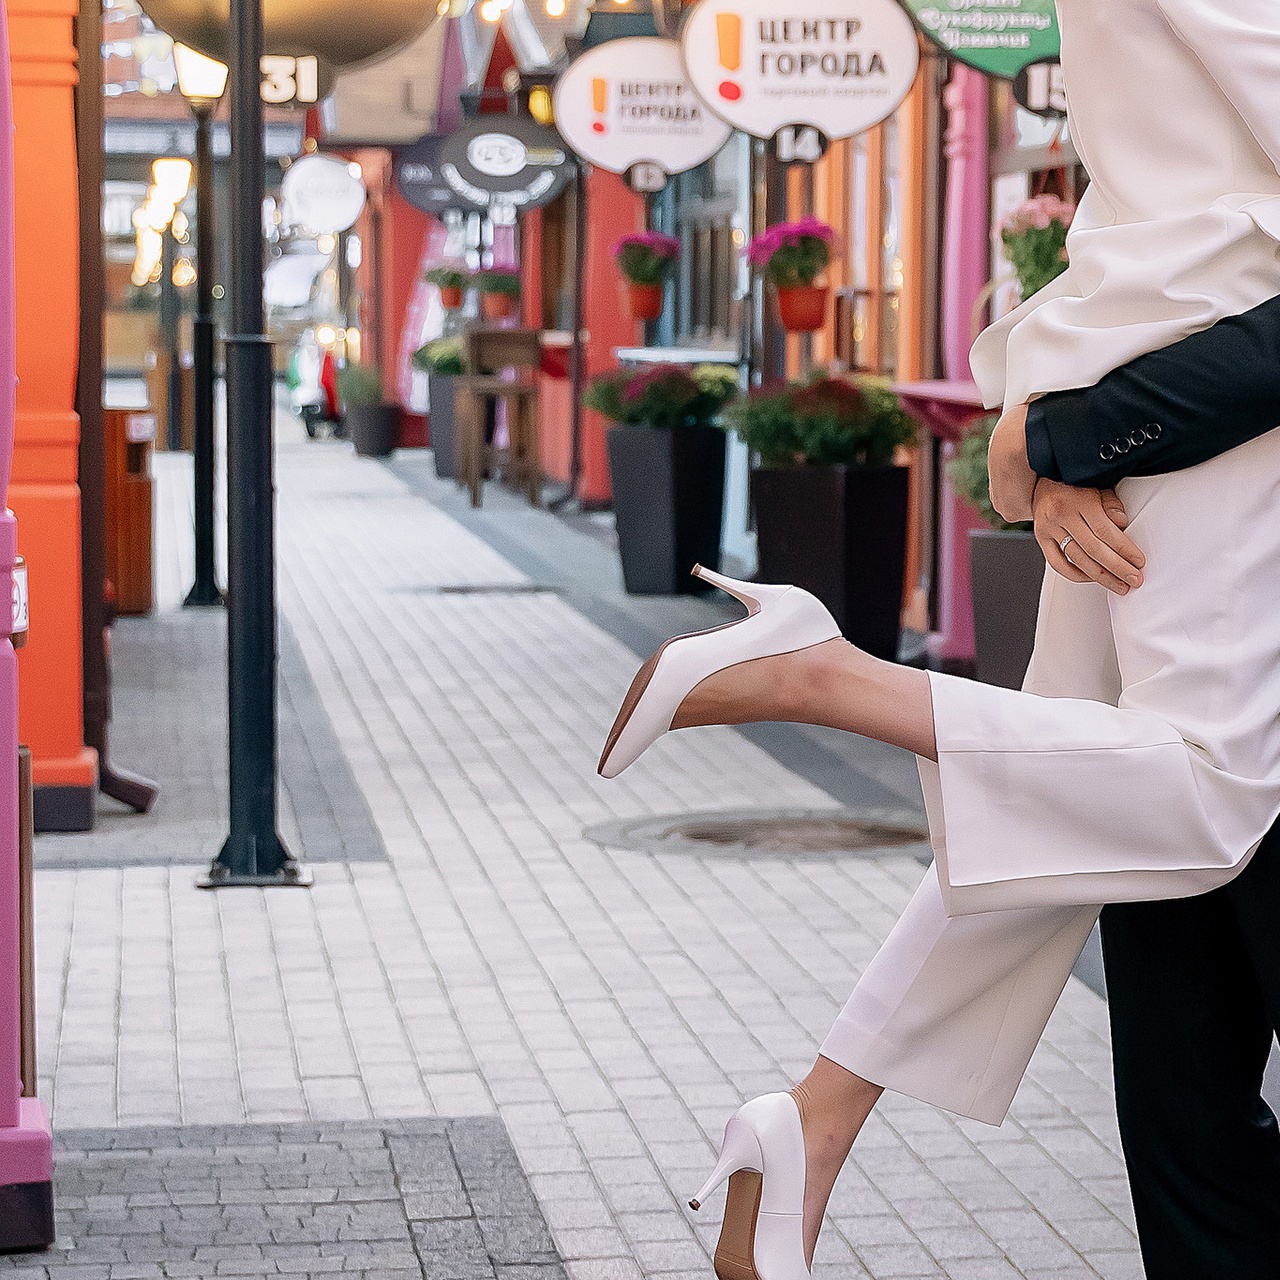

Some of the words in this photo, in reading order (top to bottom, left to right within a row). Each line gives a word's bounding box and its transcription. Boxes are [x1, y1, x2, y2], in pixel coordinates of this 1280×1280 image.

[758, 18, 862, 44] ЦЕНТР
[259, 55, 318, 104] 31
[759, 52, 886, 77] ГОРОДА
[776, 125, 823, 163] 14
